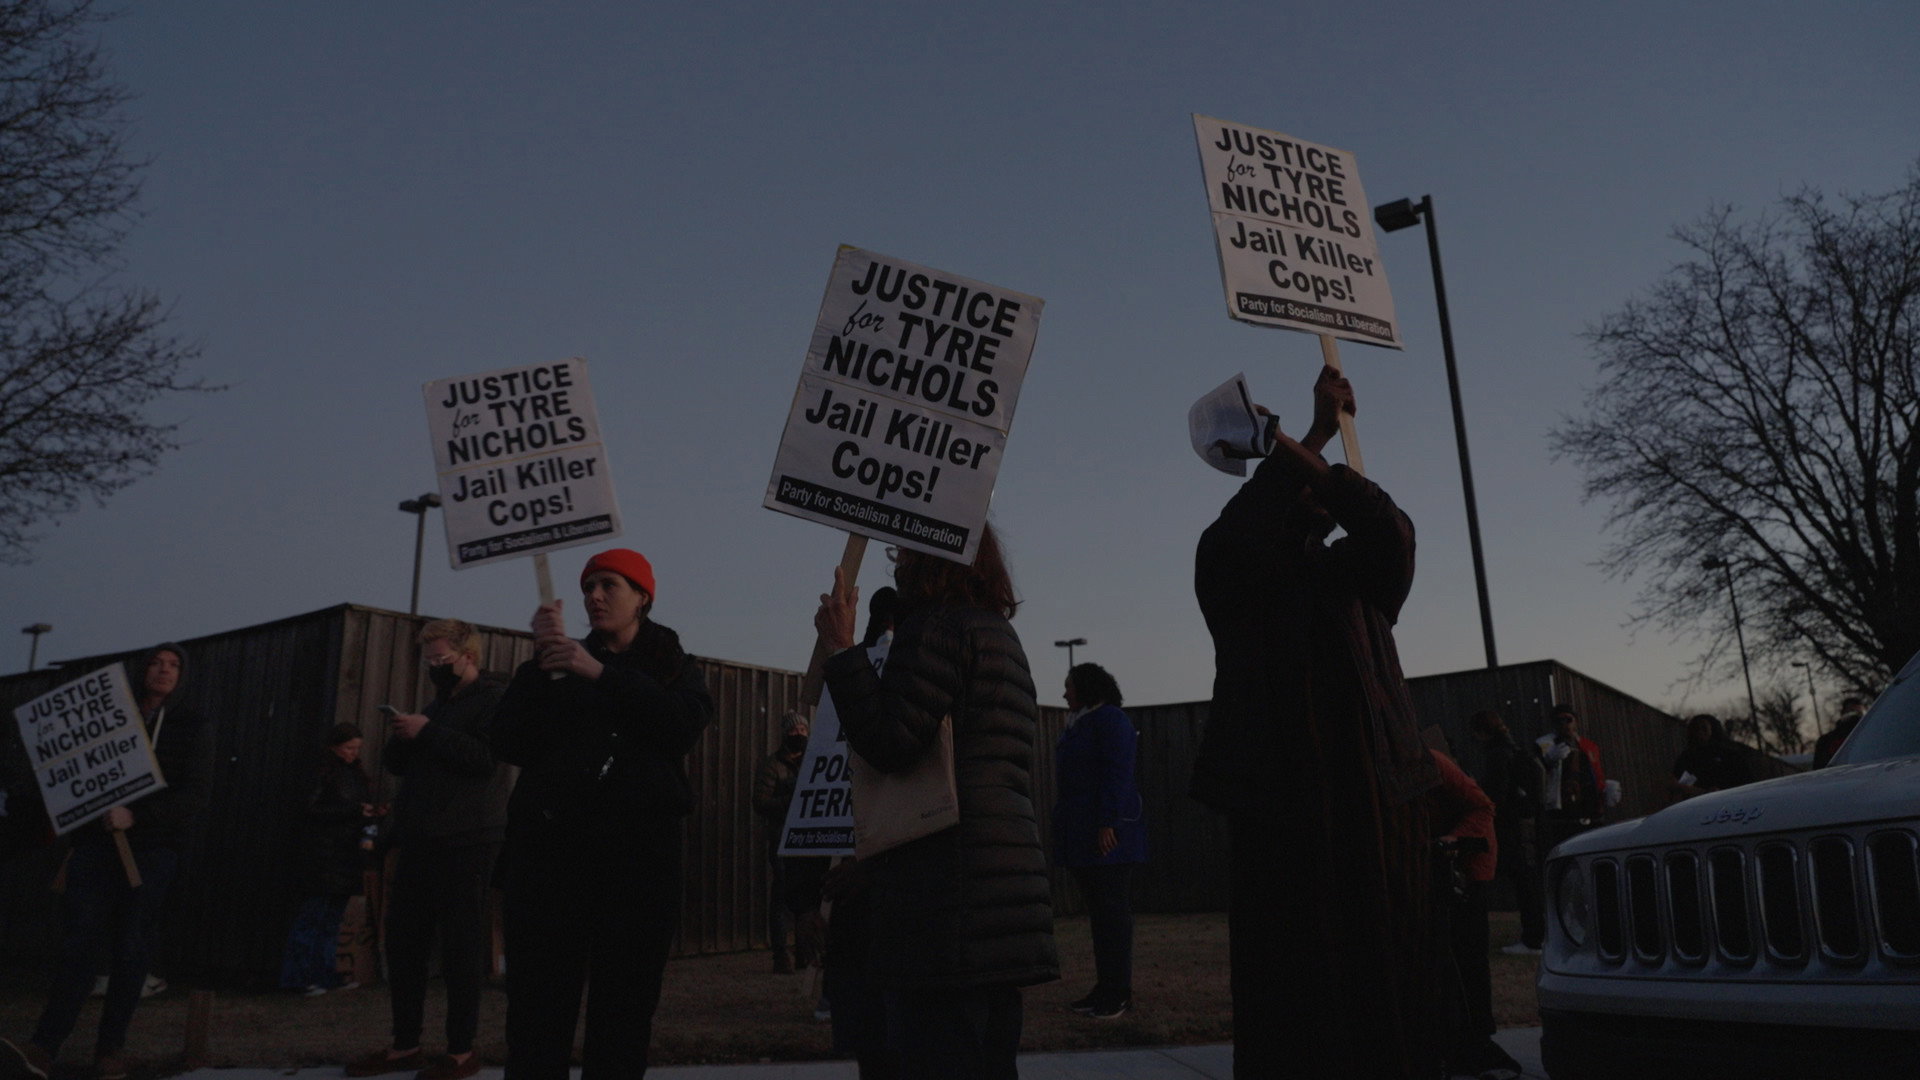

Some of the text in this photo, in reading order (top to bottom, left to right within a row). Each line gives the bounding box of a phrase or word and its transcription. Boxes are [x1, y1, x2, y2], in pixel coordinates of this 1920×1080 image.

[1215, 128, 1345, 179] JUSTICE
[1227, 155, 1347, 206] for TYRE
[1221, 182, 1361, 238] NICHOLS
[1230, 221, 1373, 276] Jail Killer
[852, 261, 1020, 337] JUSTICE
[1269, 260, 1355, 303] Cops!
[843, 300, 1000, 374] for TYRE
[1240, 296, 1391, 337] Party for Socialism & Liberation
[442, 364, 572, 408] JUSTICE
[823, 336, 998, 417] NICHOLS
[452, 391, 571, 438] for TYRE
[805, 389, 991, 470] Jail Killer
[447, 417, 586, 465] NICHOLS
[453, 457, 596, 502] Jail Killer
[831, 440, 940, 503] Cops!
[489, 487, 573, 526] Cops!
[781, 481, 963, 547] Party for Socialism & Liberation
[29, 673, 112, 723] JUSTICE
[59, 693, 115, 728] TYRE
[36, 709, 127, 762] NICHOLS
[47, 735, 138, 788] Jail Killer
[71, 760, 126, 798] Cops!
[1701, 806, 1764, 825] Jeep
